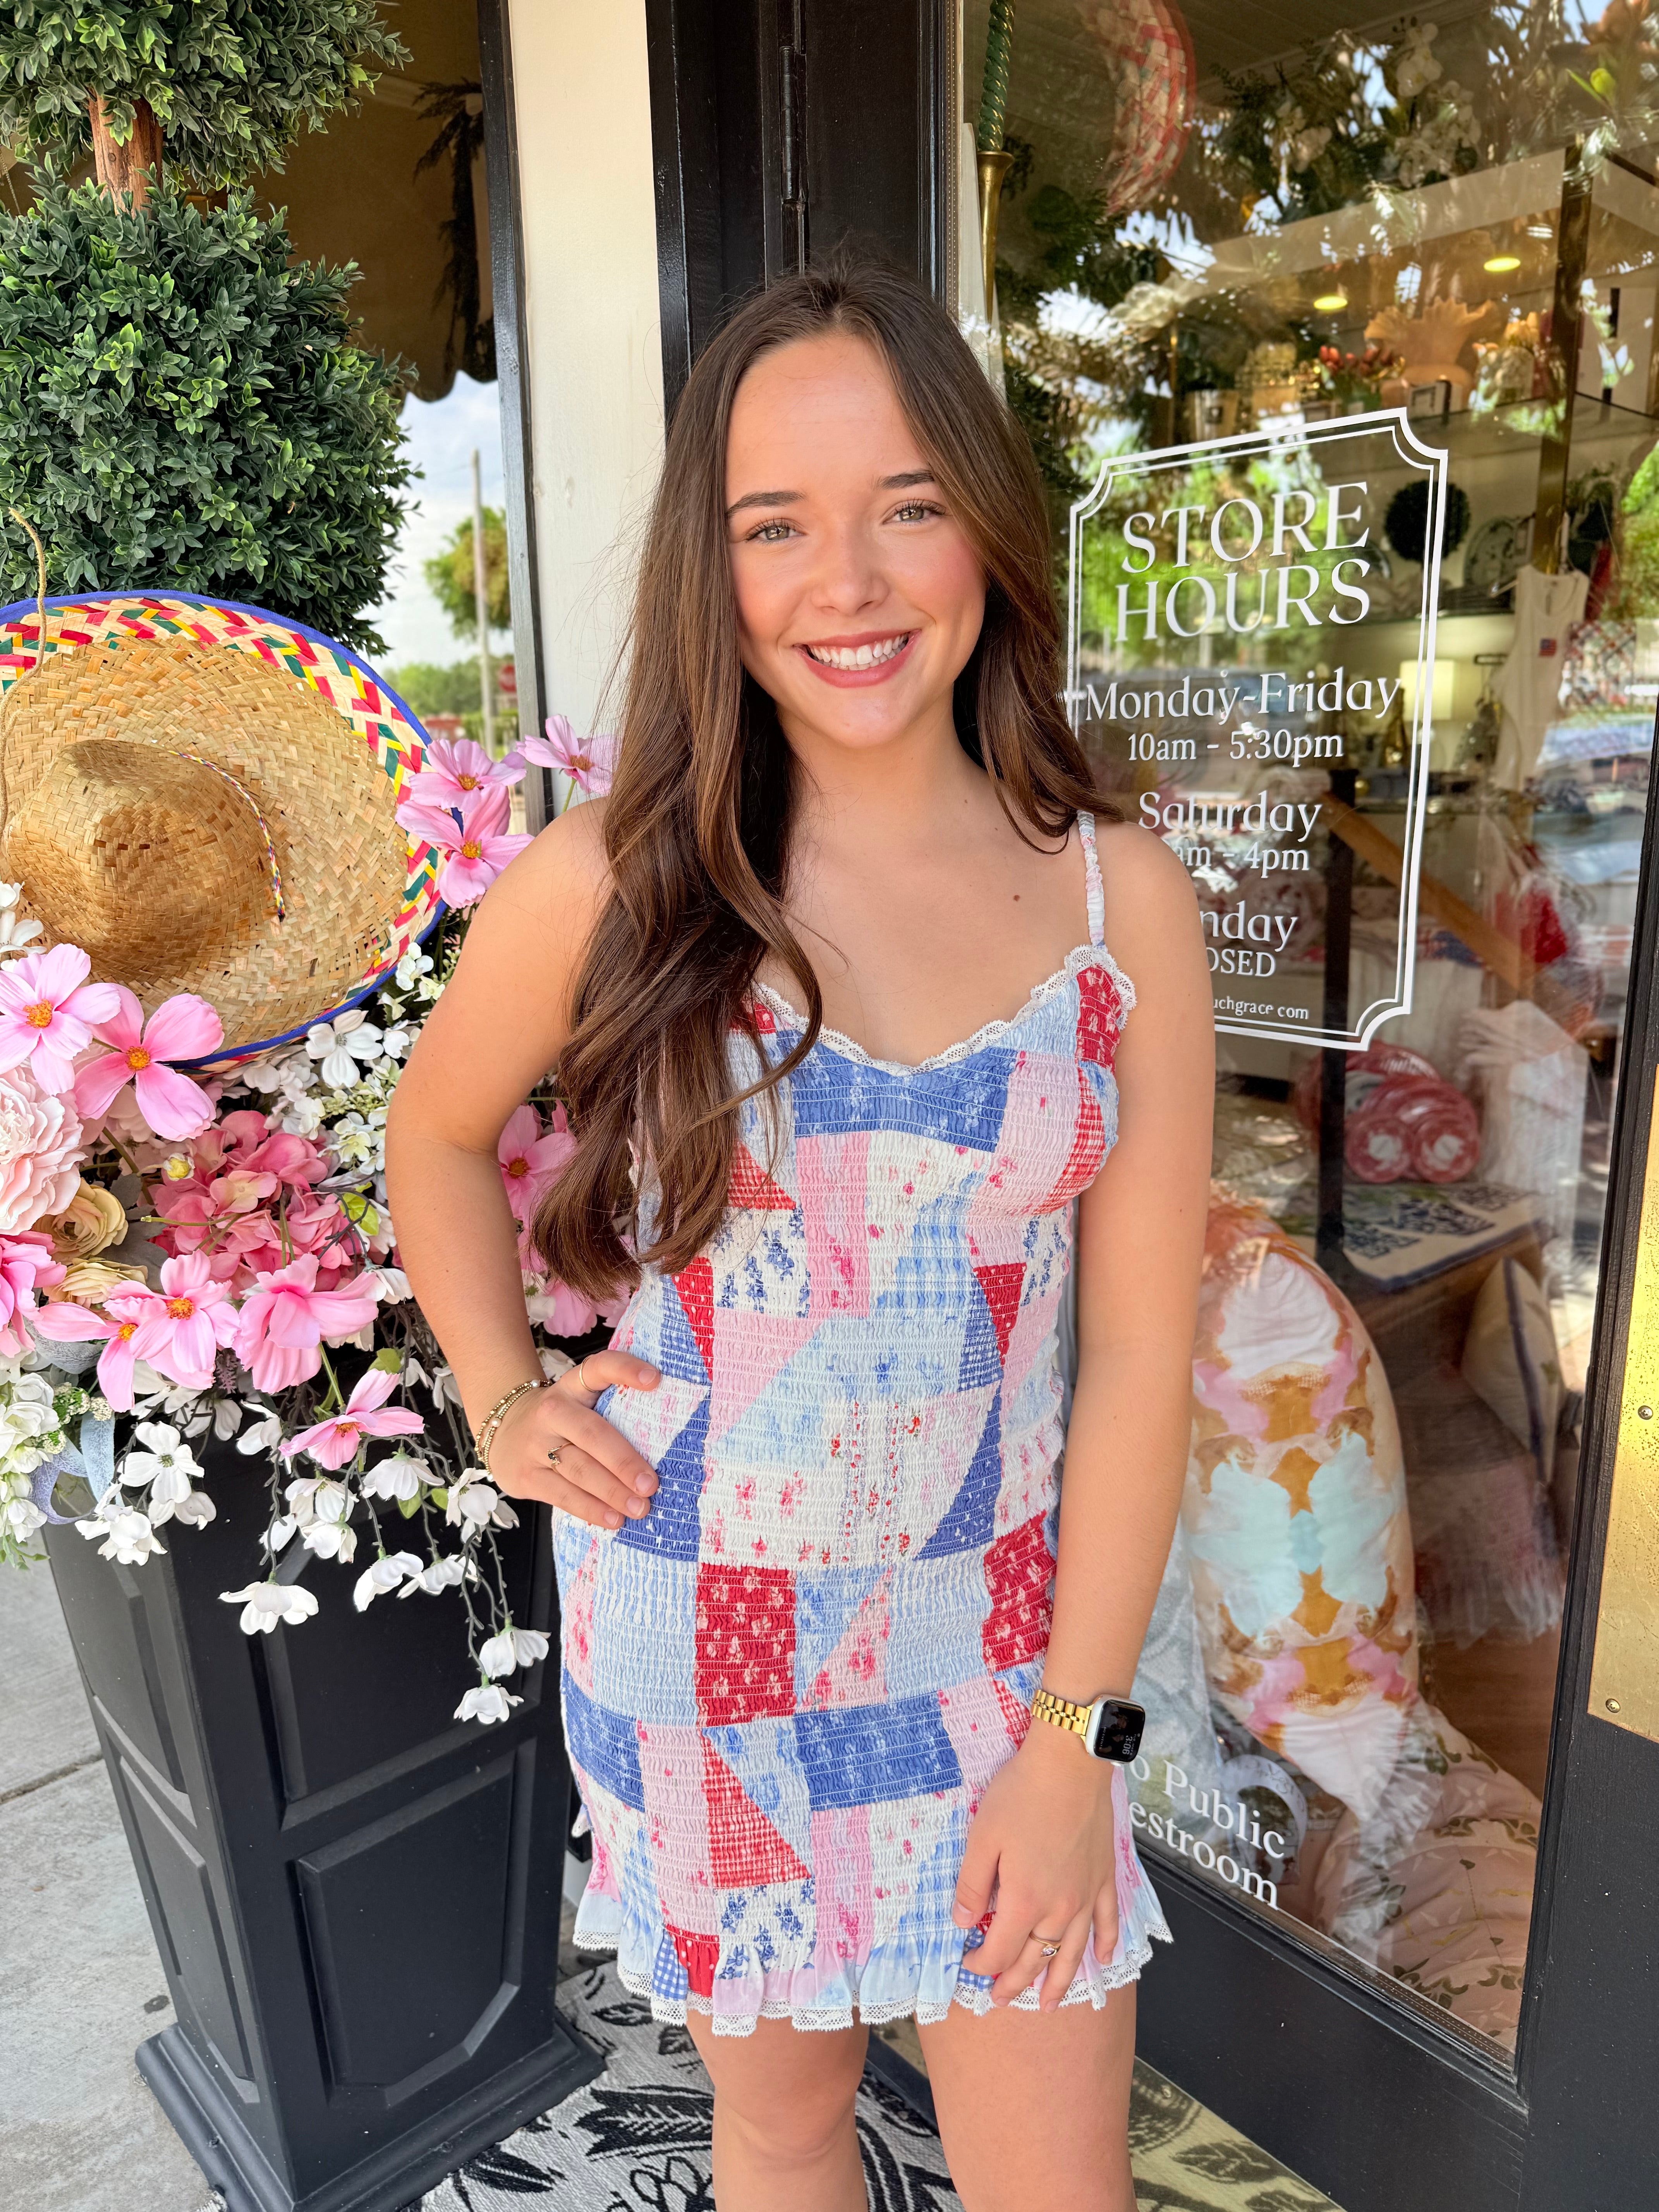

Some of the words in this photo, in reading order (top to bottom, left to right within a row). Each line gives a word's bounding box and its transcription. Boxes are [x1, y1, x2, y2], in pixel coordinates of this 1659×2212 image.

[1122, 481, 1369, 573] STORE
[1115, 559, 1370, 641] HOURS
[1085, 666, 1402, 725] Monday-Friday
[1128, 732, 1197, 761] 10am
[1230, 728, 1344, 768] 5:30pm
[1138, 790, 1322, 842] Saturday
[1163, 840, 1211, 867] am
[1243, 842, 1309, 879] 4pm
[1200, 900, 1299, 952] nday
[1206, 947, 1276, 977] OSED
[1213, 996, 1273, 1016] chgrace
[1122, 1735, 1133, 1755] 3:06
[1129, 1755, 1151, 1781] o
[1163, 1759, 1285, 1859] Public
[1128, 1802, 1279, 1911] estroom
